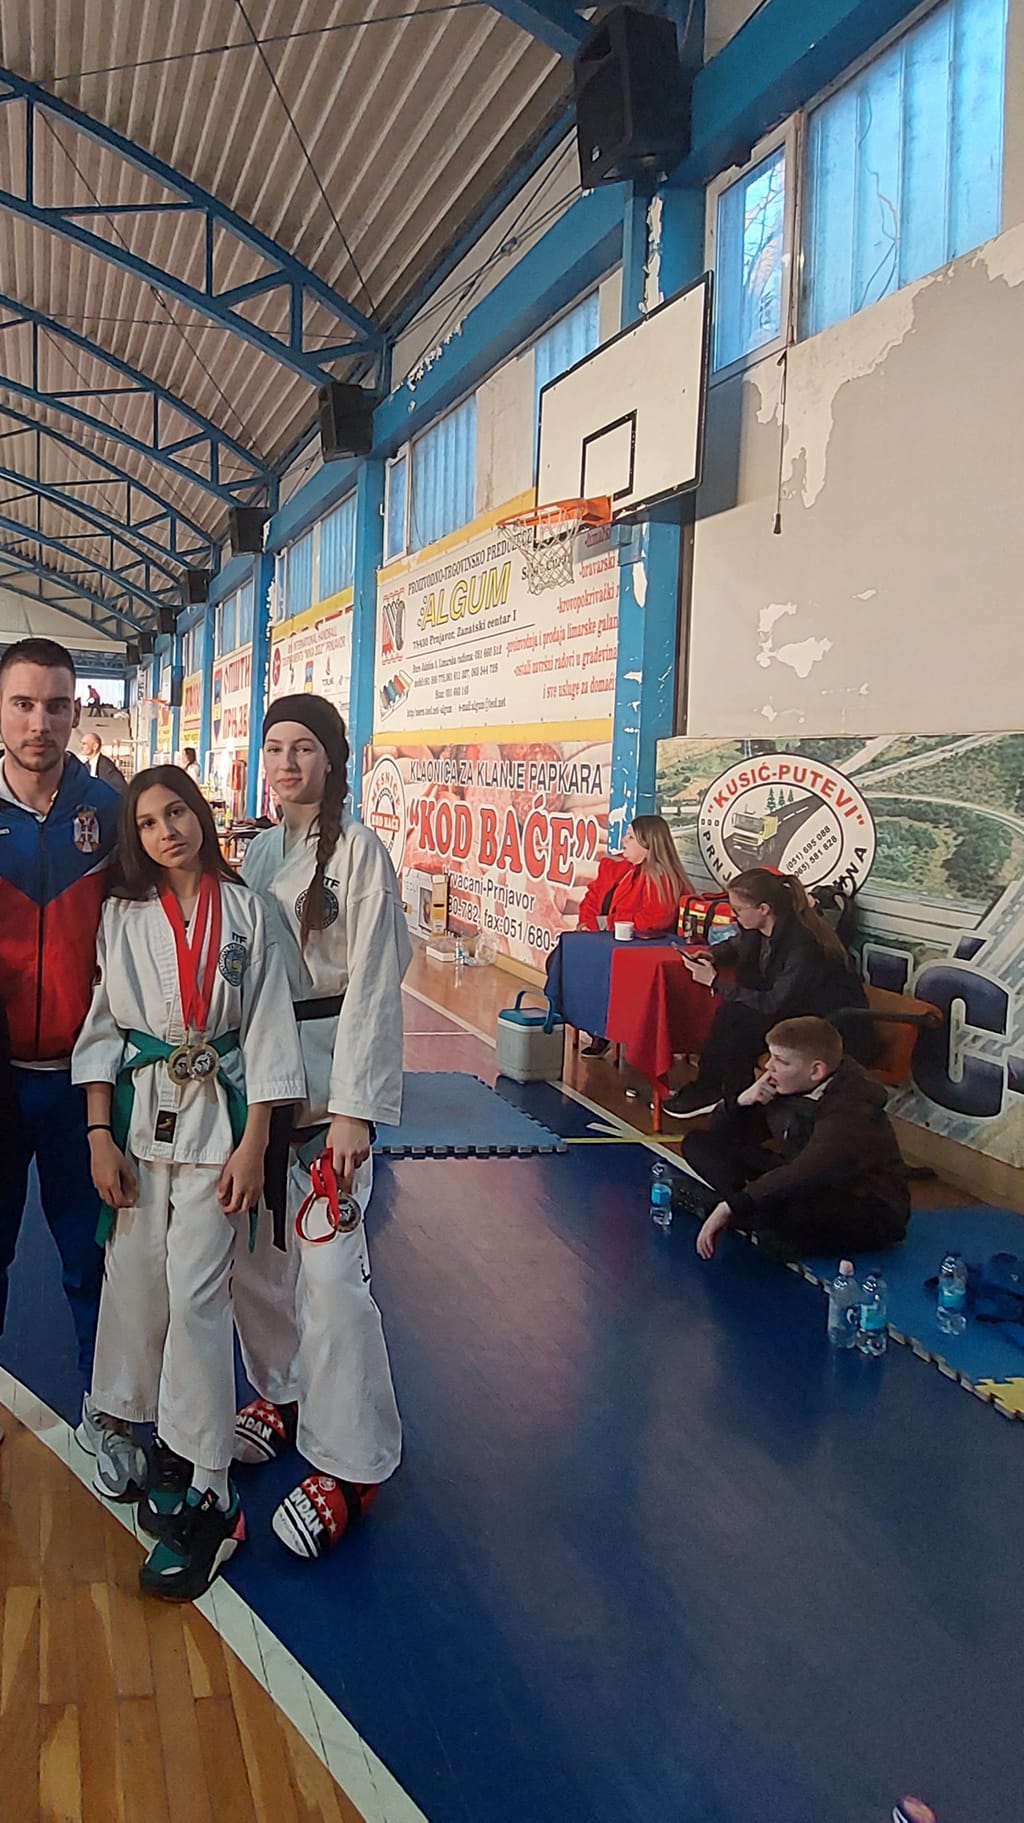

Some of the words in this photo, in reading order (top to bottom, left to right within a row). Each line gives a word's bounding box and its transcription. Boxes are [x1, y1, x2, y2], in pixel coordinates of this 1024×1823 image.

[421, 561, 512, 631] ALGUM
[410, 760, 457, 784] KLAONICA
[458, 761, 474, 786] ZA
[476, 762, 525, 791] KLANJE
[528, 762, 603, 796] PAPKARA
[802, 839, 817, 854] 695
[816, 825, 831, 841] 088
[794, 862, 810, 877] 065)
[823, 835, 838, 851] 828
[324, 876, 340, 888] TF
[232, 931, 248, 944] ITF
[236, 1415, 273, 1441] NDAN
[289, 1486, 325, 1536] NDAN
